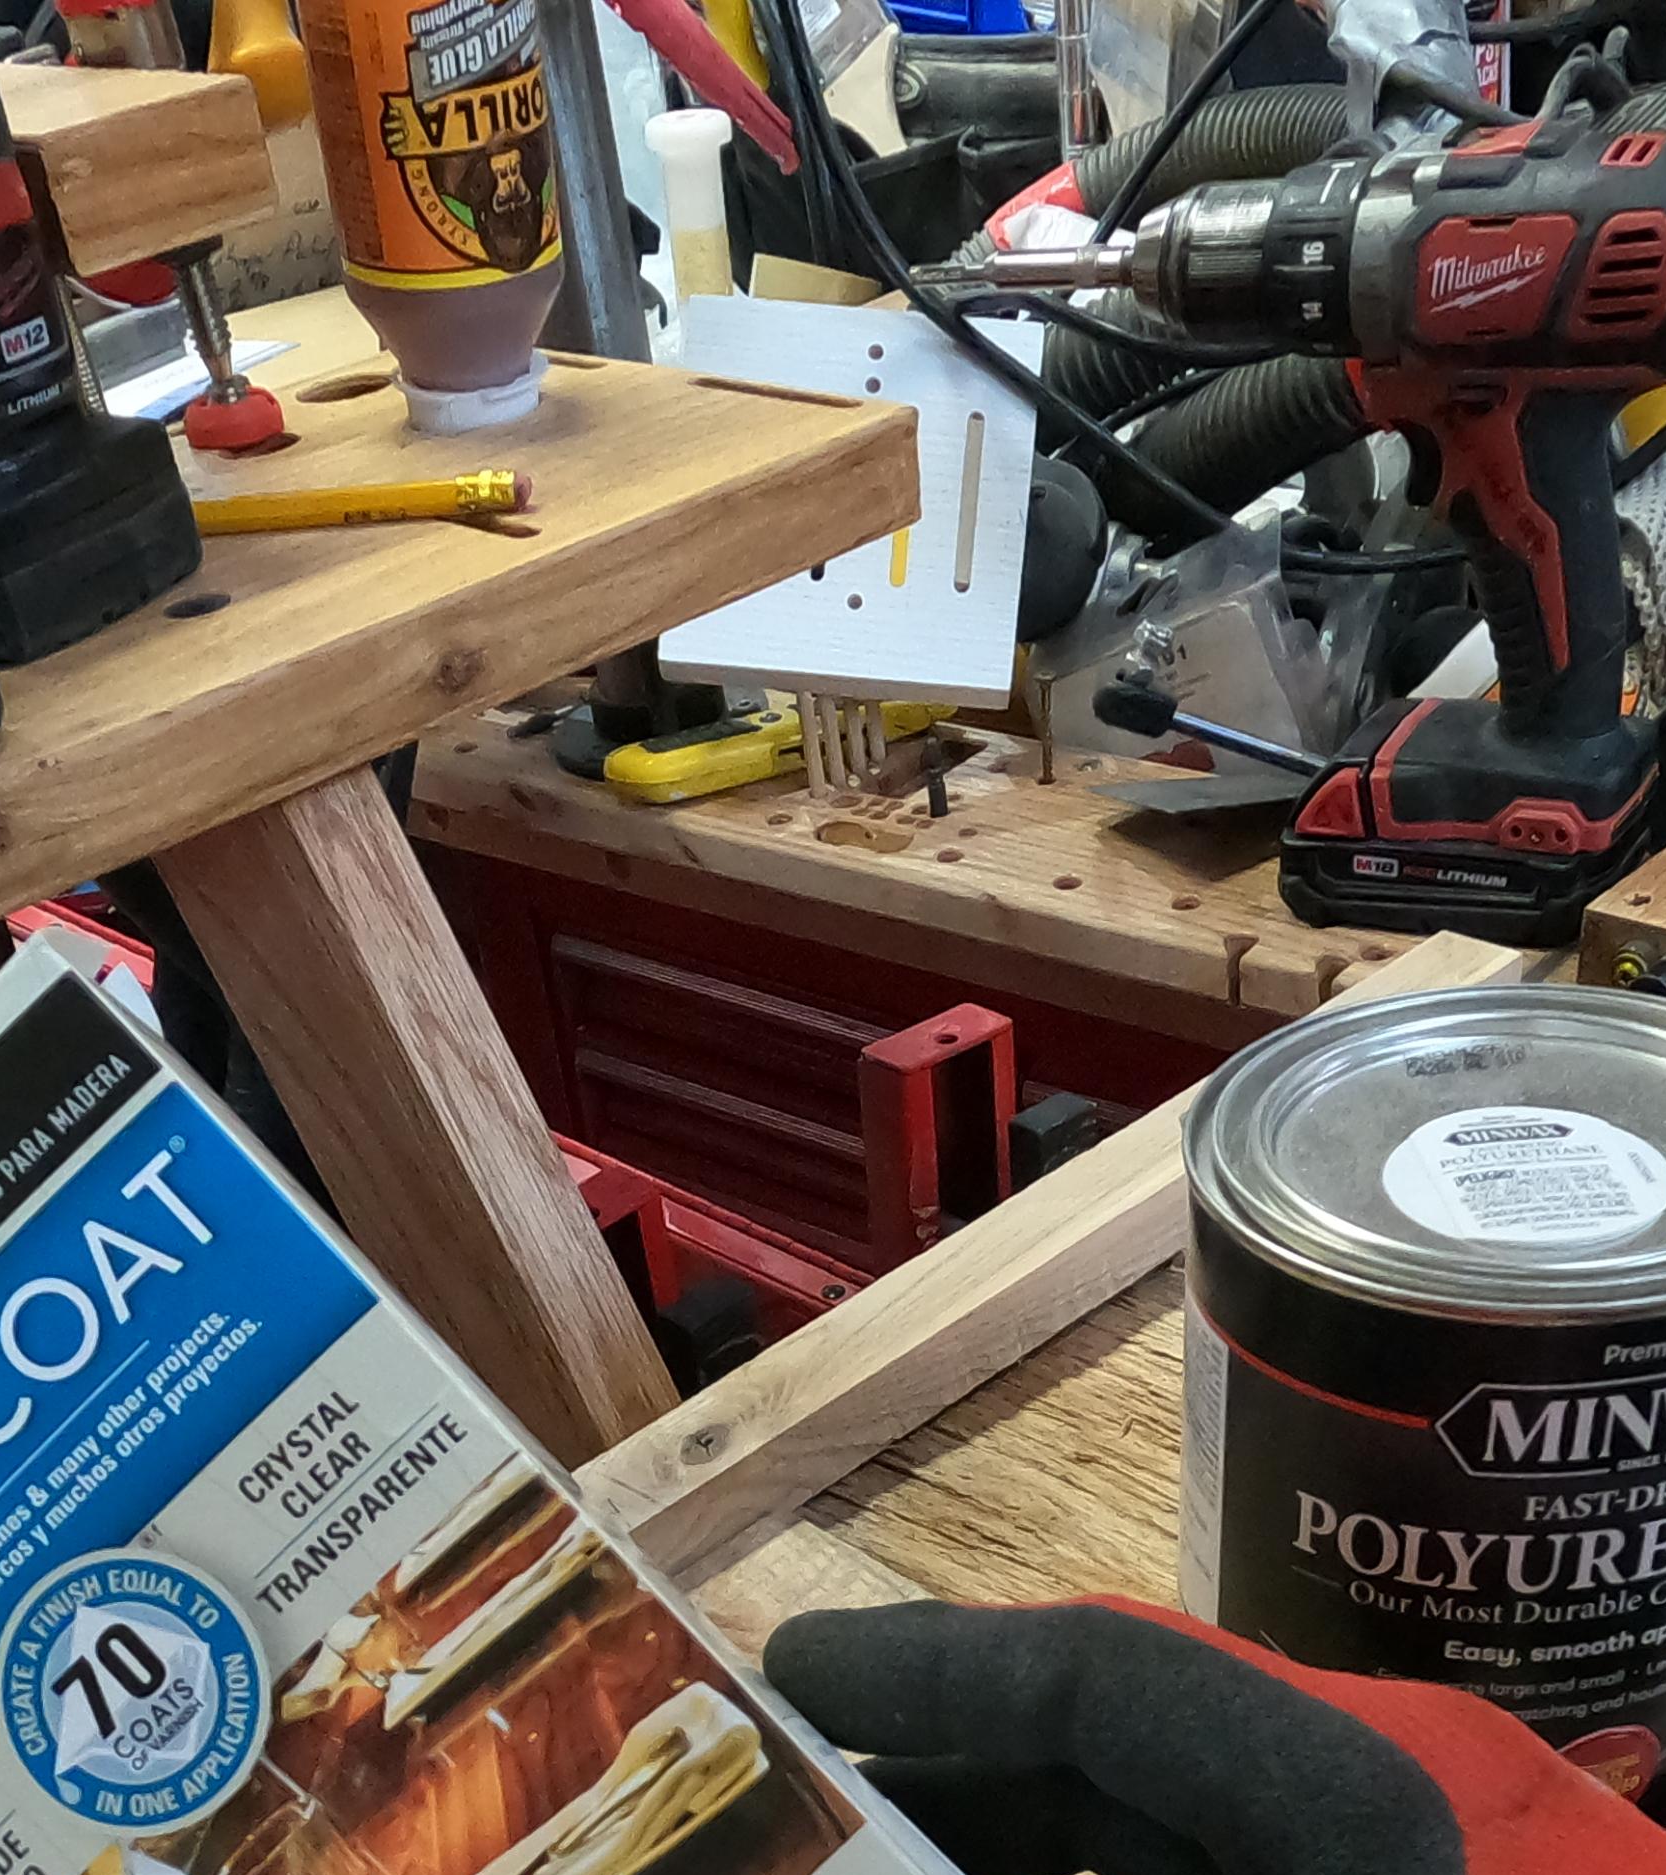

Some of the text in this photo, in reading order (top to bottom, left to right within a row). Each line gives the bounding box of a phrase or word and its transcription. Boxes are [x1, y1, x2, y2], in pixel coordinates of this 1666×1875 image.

[428, 34, 484, 87] GLUE
[412, 170, 471, 246] STRONG
[1426, 243, 1548, 299] Milwaukee
[3, 323, 46, 358] M12
[1356, 857, 1396, 875] M18
[46, 1054, 130, 1133] MADERA
[1440, 1145, 1604, 1169] POLYURETHANE
[1455, 1124, 1560, 1144] MINWAX
[160, 1306, 265, 1416] proyectos.
[22, 1479, 51, 1510] &
[44, 1432, 105, 1495] many
[92, 1380, 150, 1441] other
[141, 1299, 234, 1396] projects.
[110, 1401, 168, 1461] otros
[238, 1391, 359, 1503] CRYSTAL
[280, 1431, 371, 1518] CLEAR
[40, 1449, 120, 1532] muchos
[254, 1414, 466, 1613] TRANSPARENTE
[29, 1522, 53, 1548] y
[1348, 1579, 1407, 1615] Our
[1421, 1595, 1504, 1625] Most
[1514, 1590, 1643, 1626] Durable
[11, 1566, 221, 1753] CREATE A FINISH EQUAL TO
[50, 1623, 166, 1739] 70
[1444, 1640, 1523, 1669] Easy,
[1530, 1630, 1635, 1663] smooth
[96, 1653, 253, 1814] IN ONE APPLICATION
[109, 1673, 197, 1764] COATS
